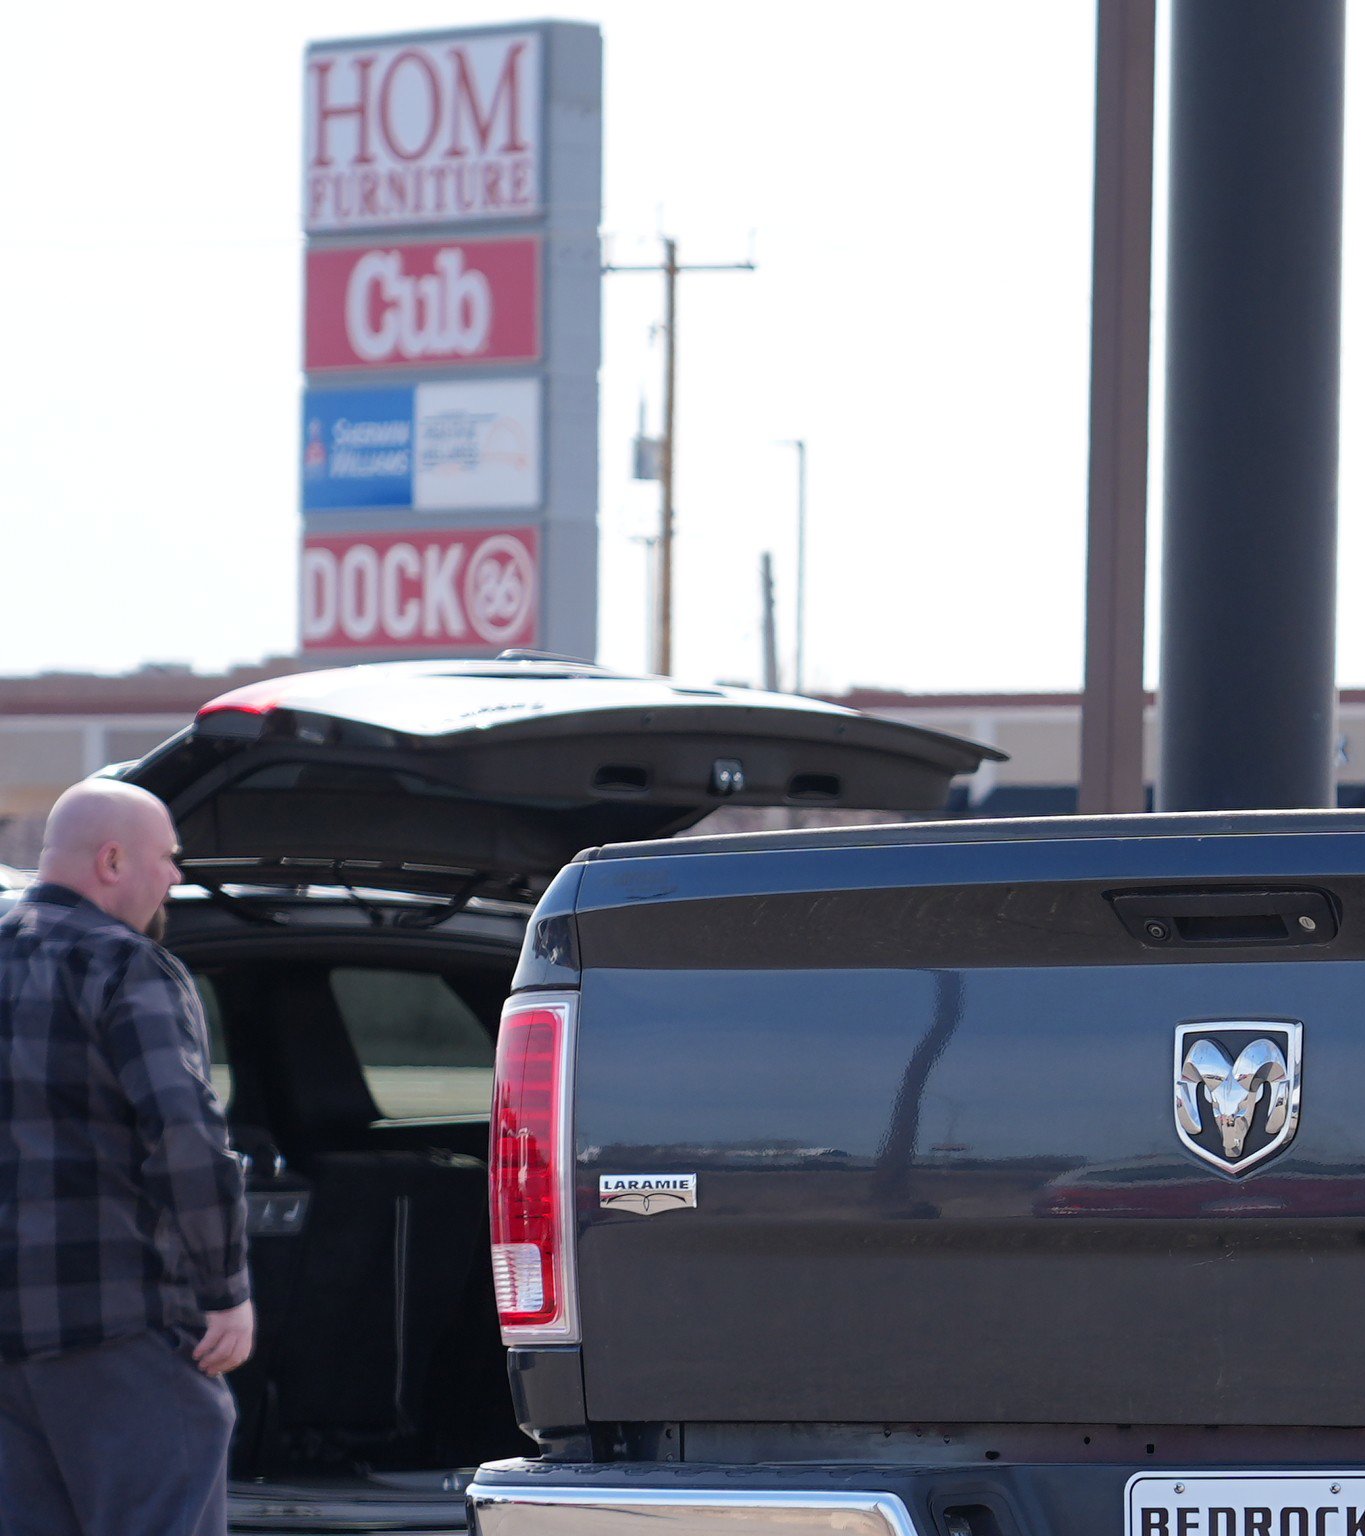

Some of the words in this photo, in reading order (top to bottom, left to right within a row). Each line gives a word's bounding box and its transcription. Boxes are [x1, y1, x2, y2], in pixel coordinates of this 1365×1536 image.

[307, 41, 530, 167] HOM
[308, 157, 532, 221] FURNITURE
[345, 246, 493, 362] Cub
[302, 541, 467, 641] DOCK
[604, 1180, 690, 1190] LARAMIE
